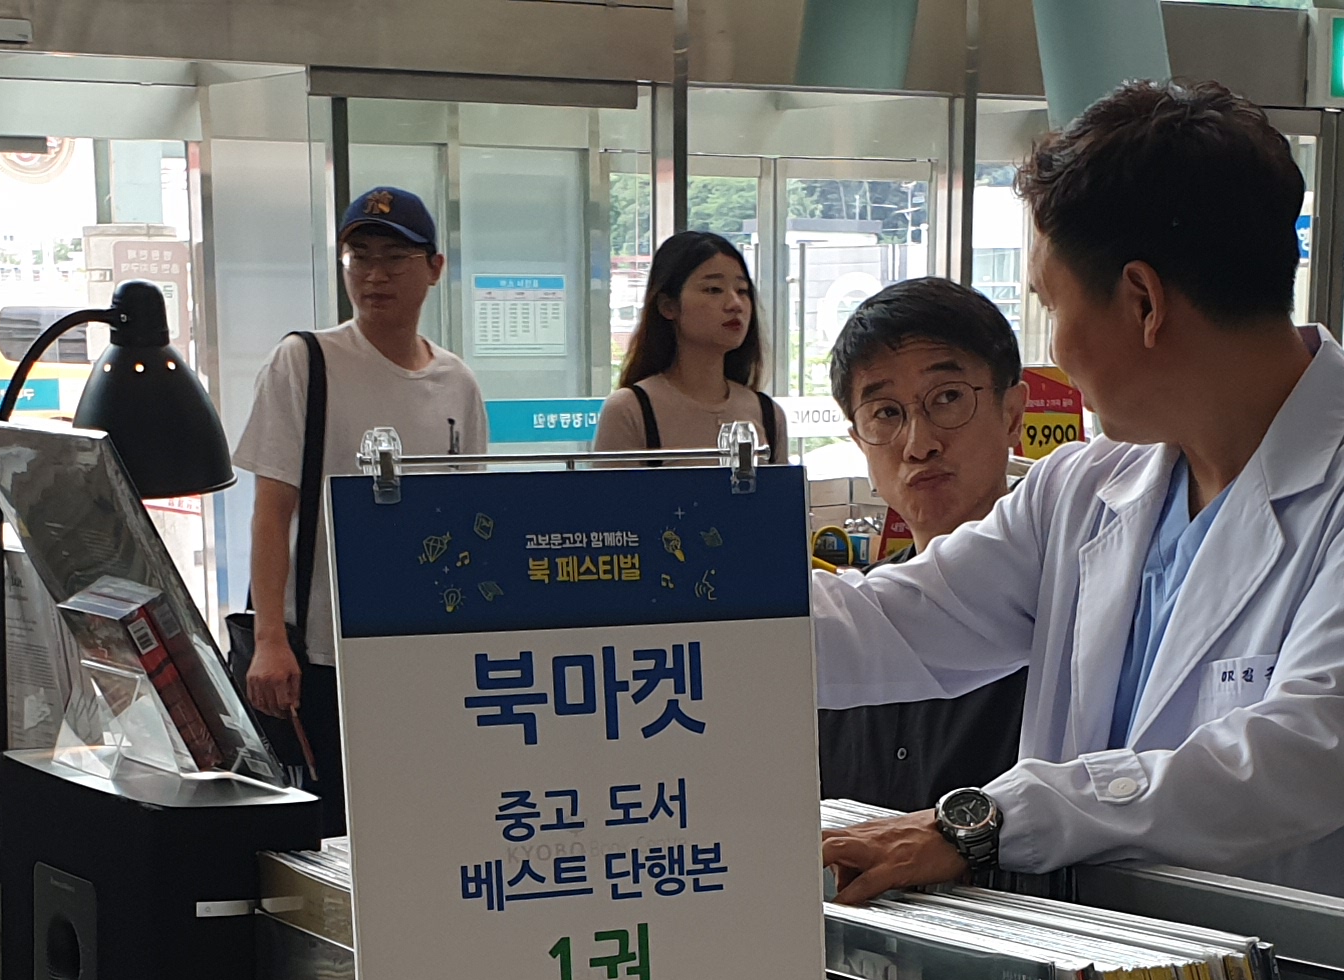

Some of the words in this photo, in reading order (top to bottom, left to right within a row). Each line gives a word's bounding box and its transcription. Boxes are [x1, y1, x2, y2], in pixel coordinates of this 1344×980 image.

[1026, 424, 1077, 447] 9,900
[525, 532, 588, 549] 교보문고와
[590, 530, 640, 548] 함께하는
[528, 556, 551, 584] 북
[555, 553, 641, 583] 페스티벌
[463, 641, 707, 746] 북마켓
[495, 790, 586, 843] 중고
[604, 777, 691, 830] 도서
[459, 857, 594, 912] 베스트
[604, 842, 729, 900] 단행본
